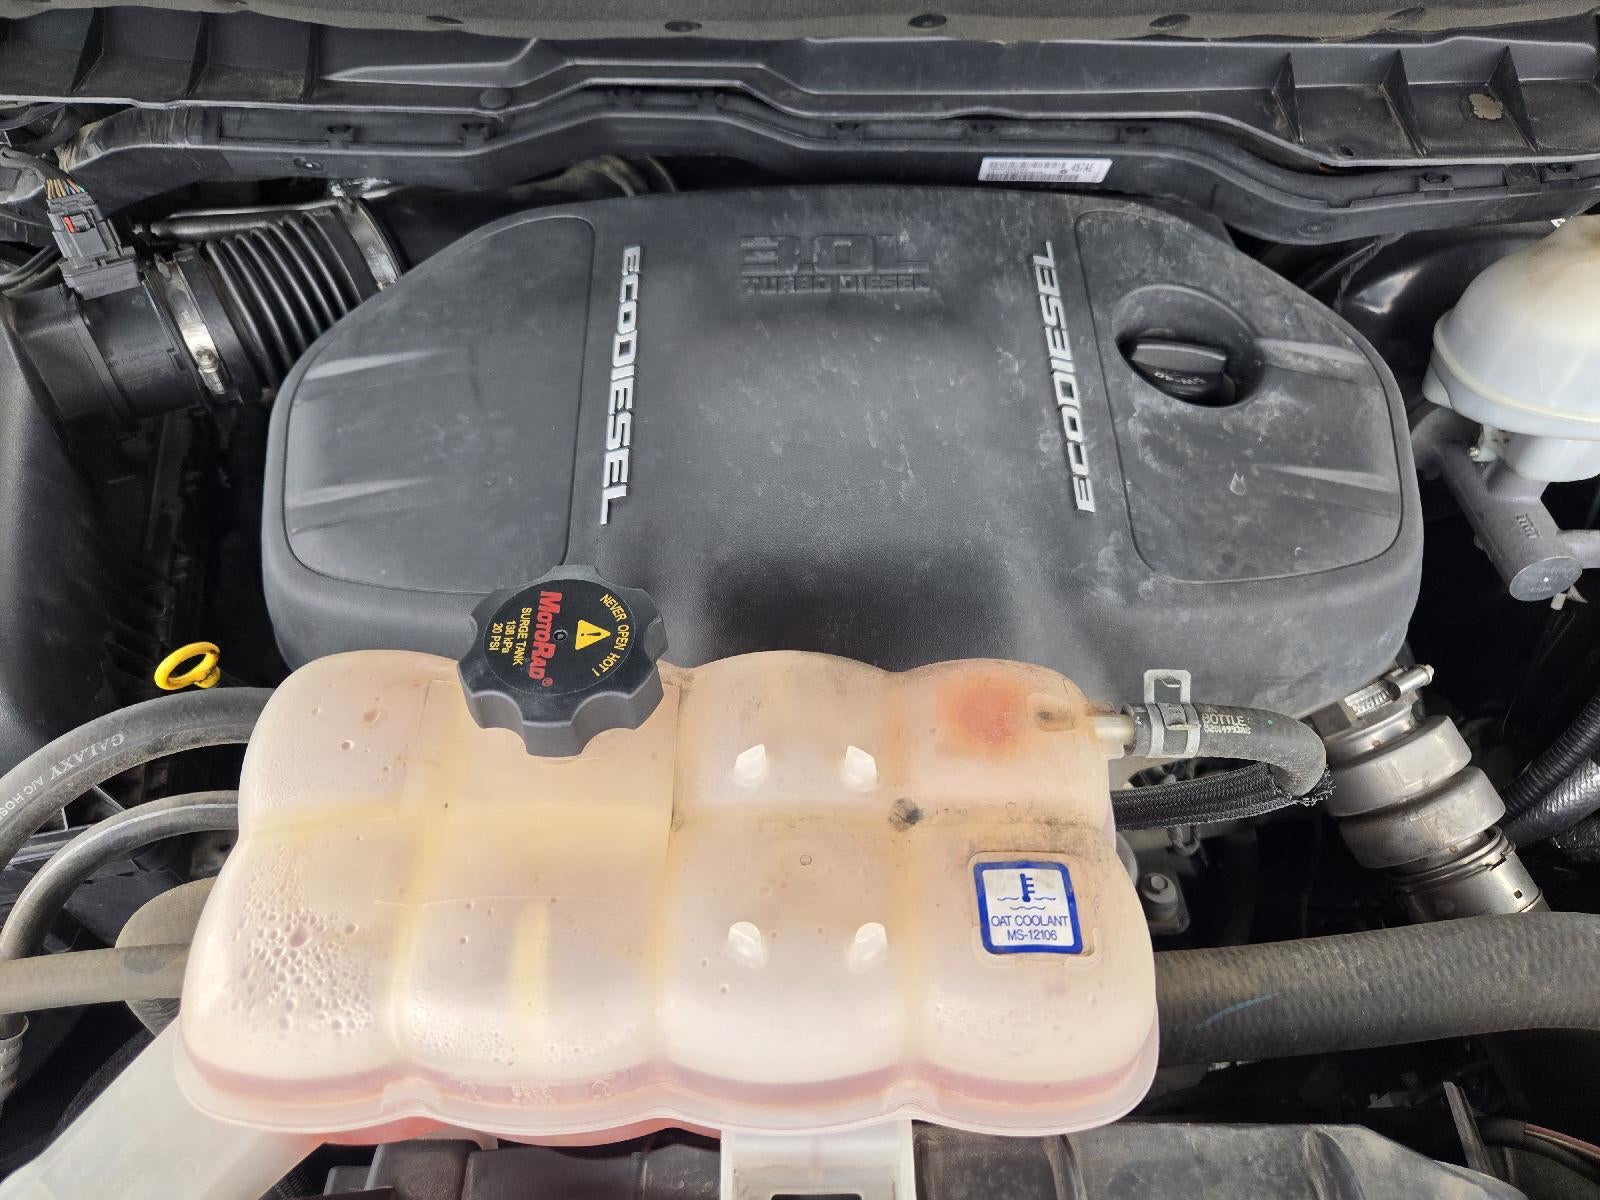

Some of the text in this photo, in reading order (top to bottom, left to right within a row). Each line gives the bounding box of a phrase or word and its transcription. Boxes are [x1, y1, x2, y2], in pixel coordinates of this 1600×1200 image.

[741, 275, 930, 293] TURBO DIESEL
[599, 246, 641, 526] ECODIESEL
[1032, 240, 1096, 513] ECODIESEL
[600, 593, 628, 622] NEVER
[488, 622, 504, 651] 20 PSI
[504, 619, 517, 636] 138
[512, 607, 533, 667] SURGE TANK
[613, 624, 630, 651] OPEN
[1201, 713, 1247, 726] BOTTLE
[0, 732, 125, 818] GALAXY A/C HOS
[990, 915, 1069, 927] OAT COOLANT
[1006, 929, 1058, 941] MS-12106
